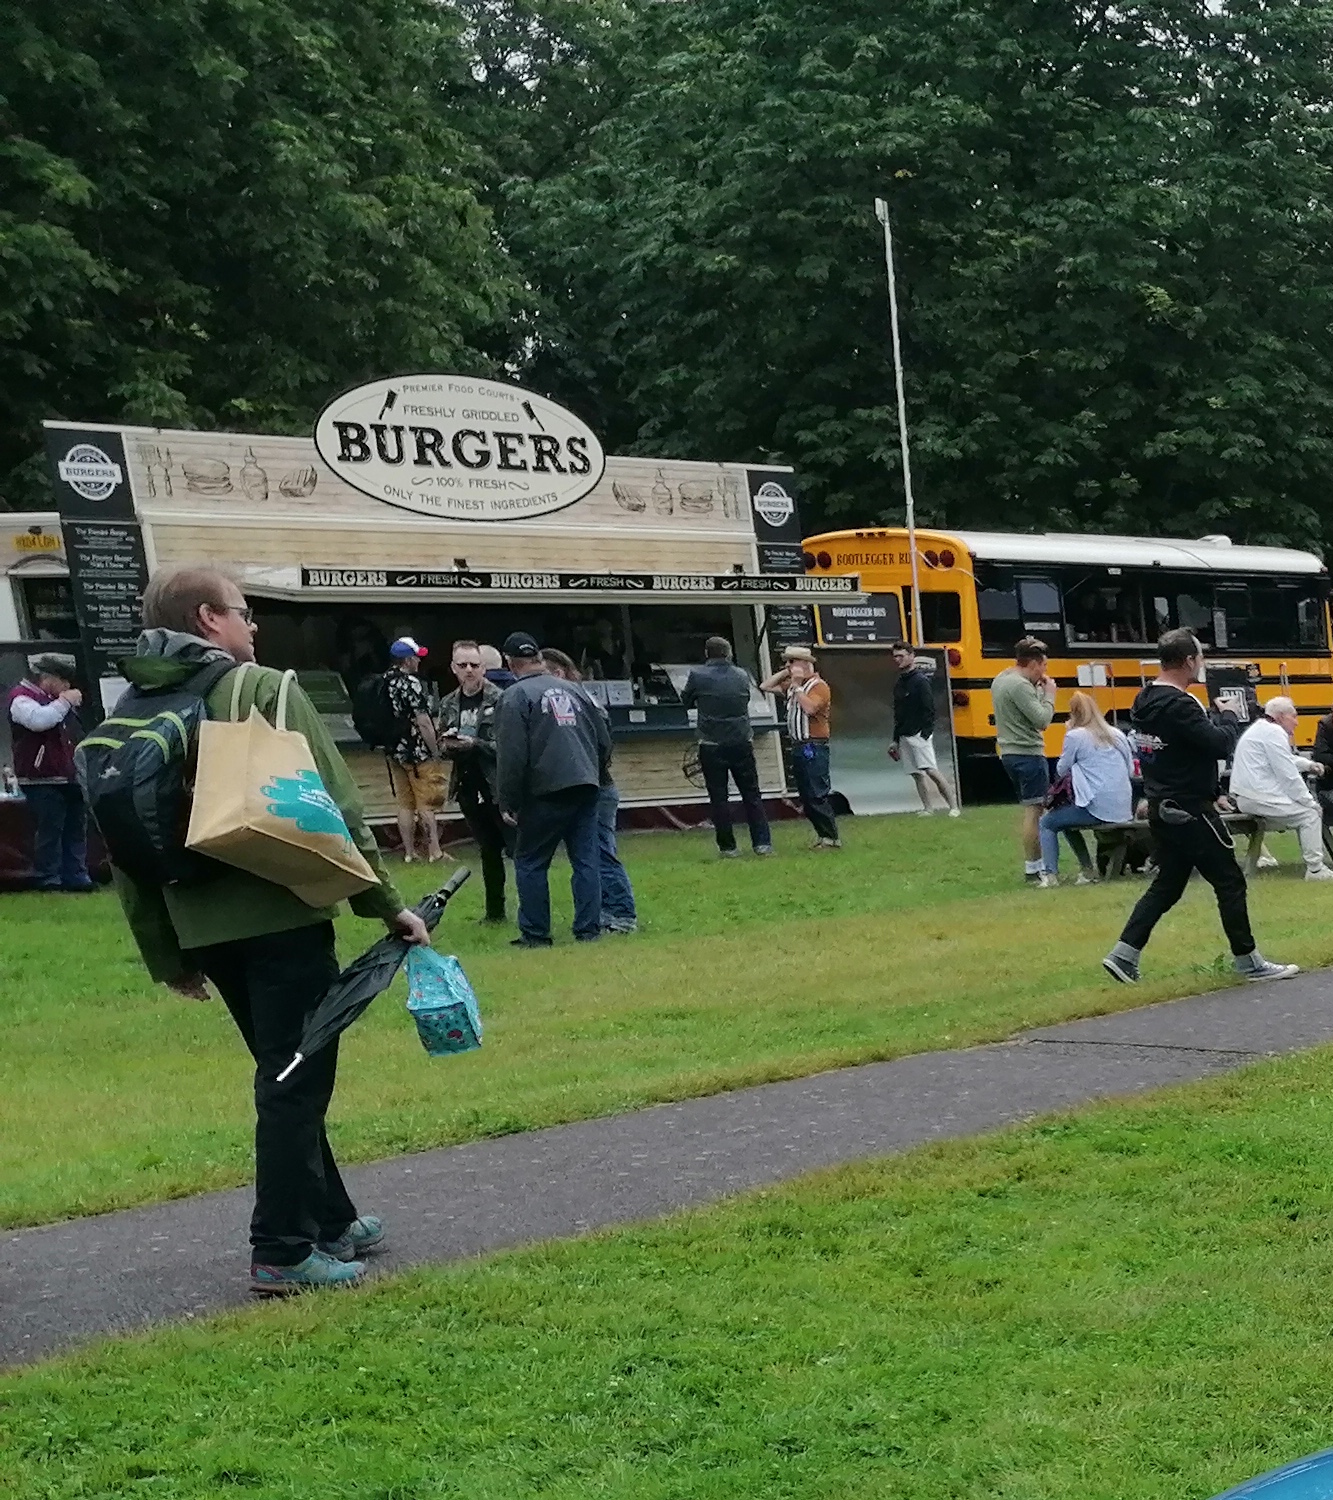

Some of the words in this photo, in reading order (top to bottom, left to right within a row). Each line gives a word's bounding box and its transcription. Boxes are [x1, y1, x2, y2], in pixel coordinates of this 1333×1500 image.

[448, 383, 474, 394] FOOD
[402, 404, 456, 419] FRESHLY
[462, 408, 520, 423] GRIDDLED
[332, 420, 593, 477] BURGERS
[65, 467, 116, 478] BURGERS
[435, 477, 464, 488] 100%
[468, 478, 507, 490] FRESH
[383, 485, 414, 501] ONLY
[419, 493, 443, 507] THE
[447, 498, 486, 512] FINEST
[490, 492, 558, 511] INGREDIENTS
[836, 553, 895, 566] BOOTLEGGER
[898, 553, 912, 565] BU
[308, 569, 388, 587] BURGERS
[420, 573, 459, 586] FRESH
[490, 573, 561, 589] BURGERS
[589, 576, 625, 588] FRESH
[652, 575, 715, 590] BURGERS
[740, 579, 772, 589] FRESH
[795, 577, 852, 592] BURGERS
